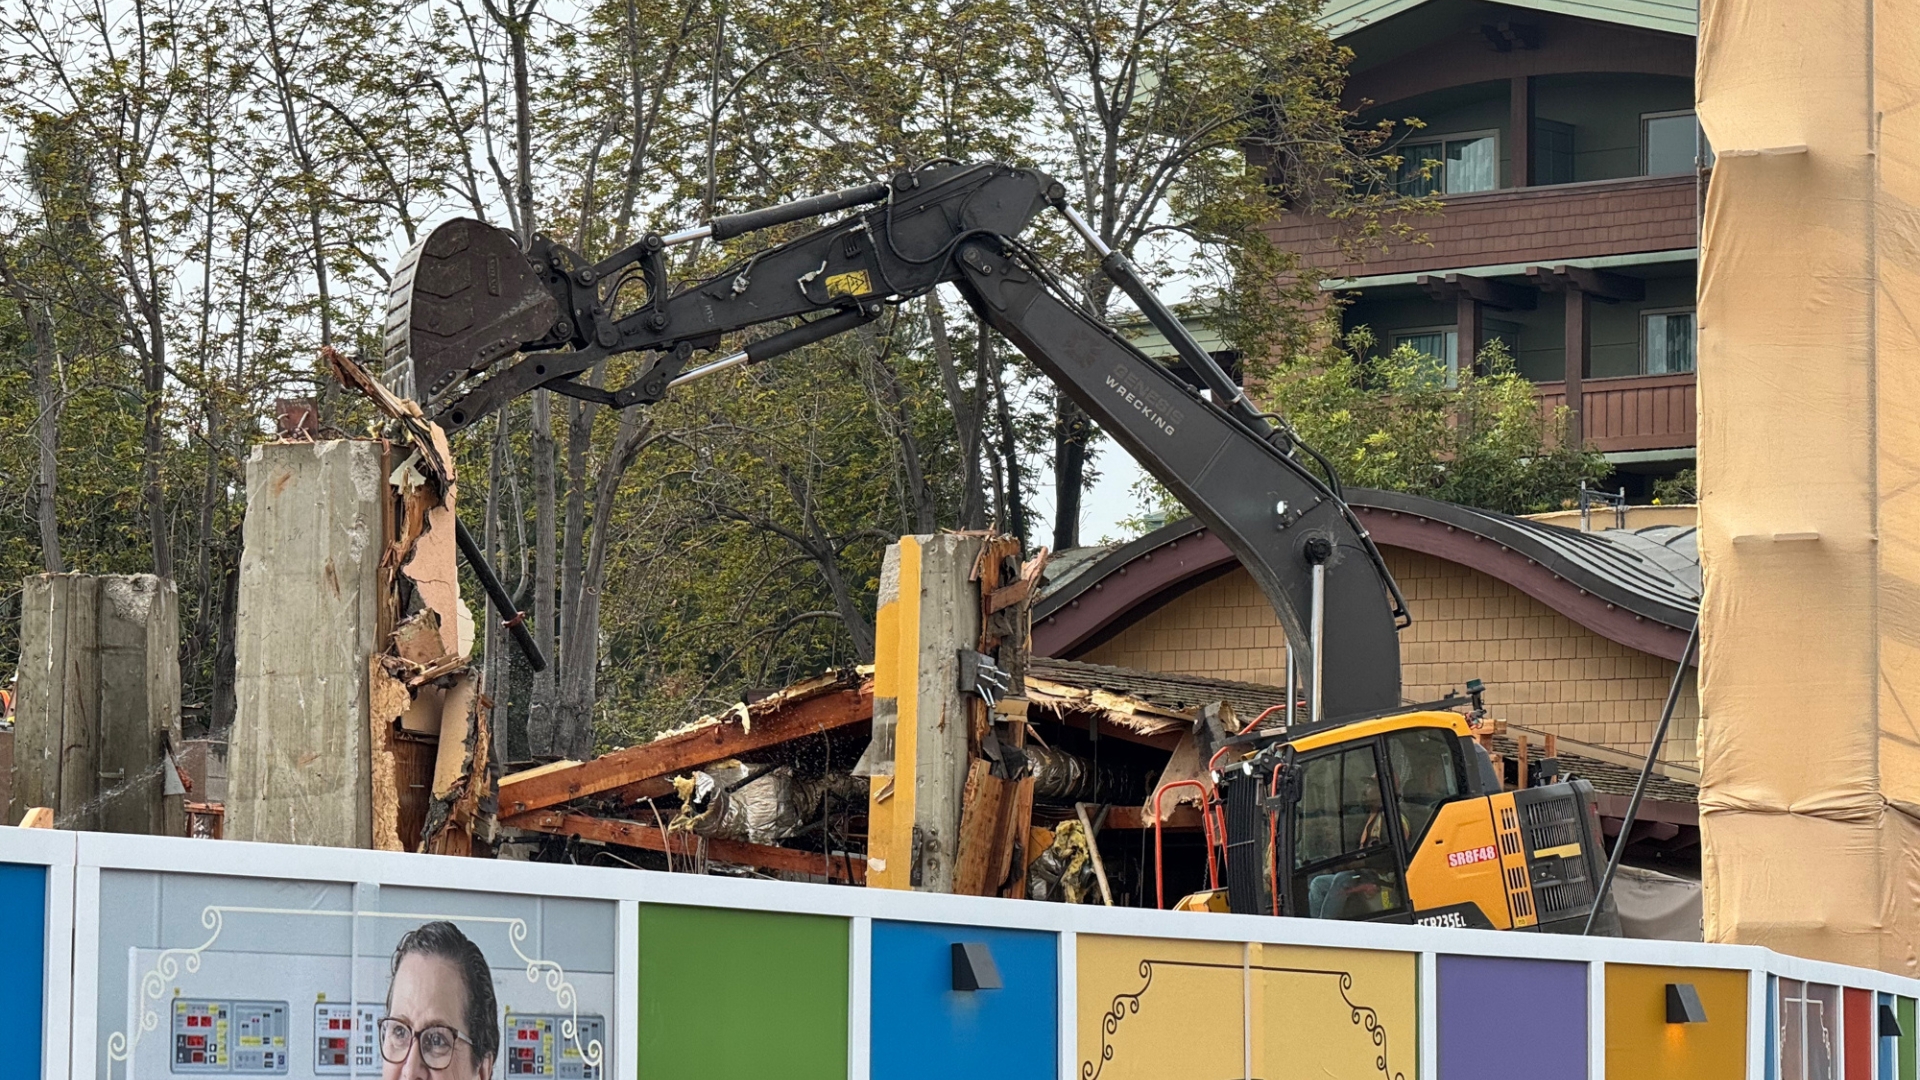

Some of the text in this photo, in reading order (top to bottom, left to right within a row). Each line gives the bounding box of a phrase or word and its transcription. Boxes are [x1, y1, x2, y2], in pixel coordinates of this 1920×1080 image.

[1105, 374, 1175, 436] WRECKING
[1113, 363, 1185, 425] GENESIS
[1448, 845, 1496, 867] SR8F48
